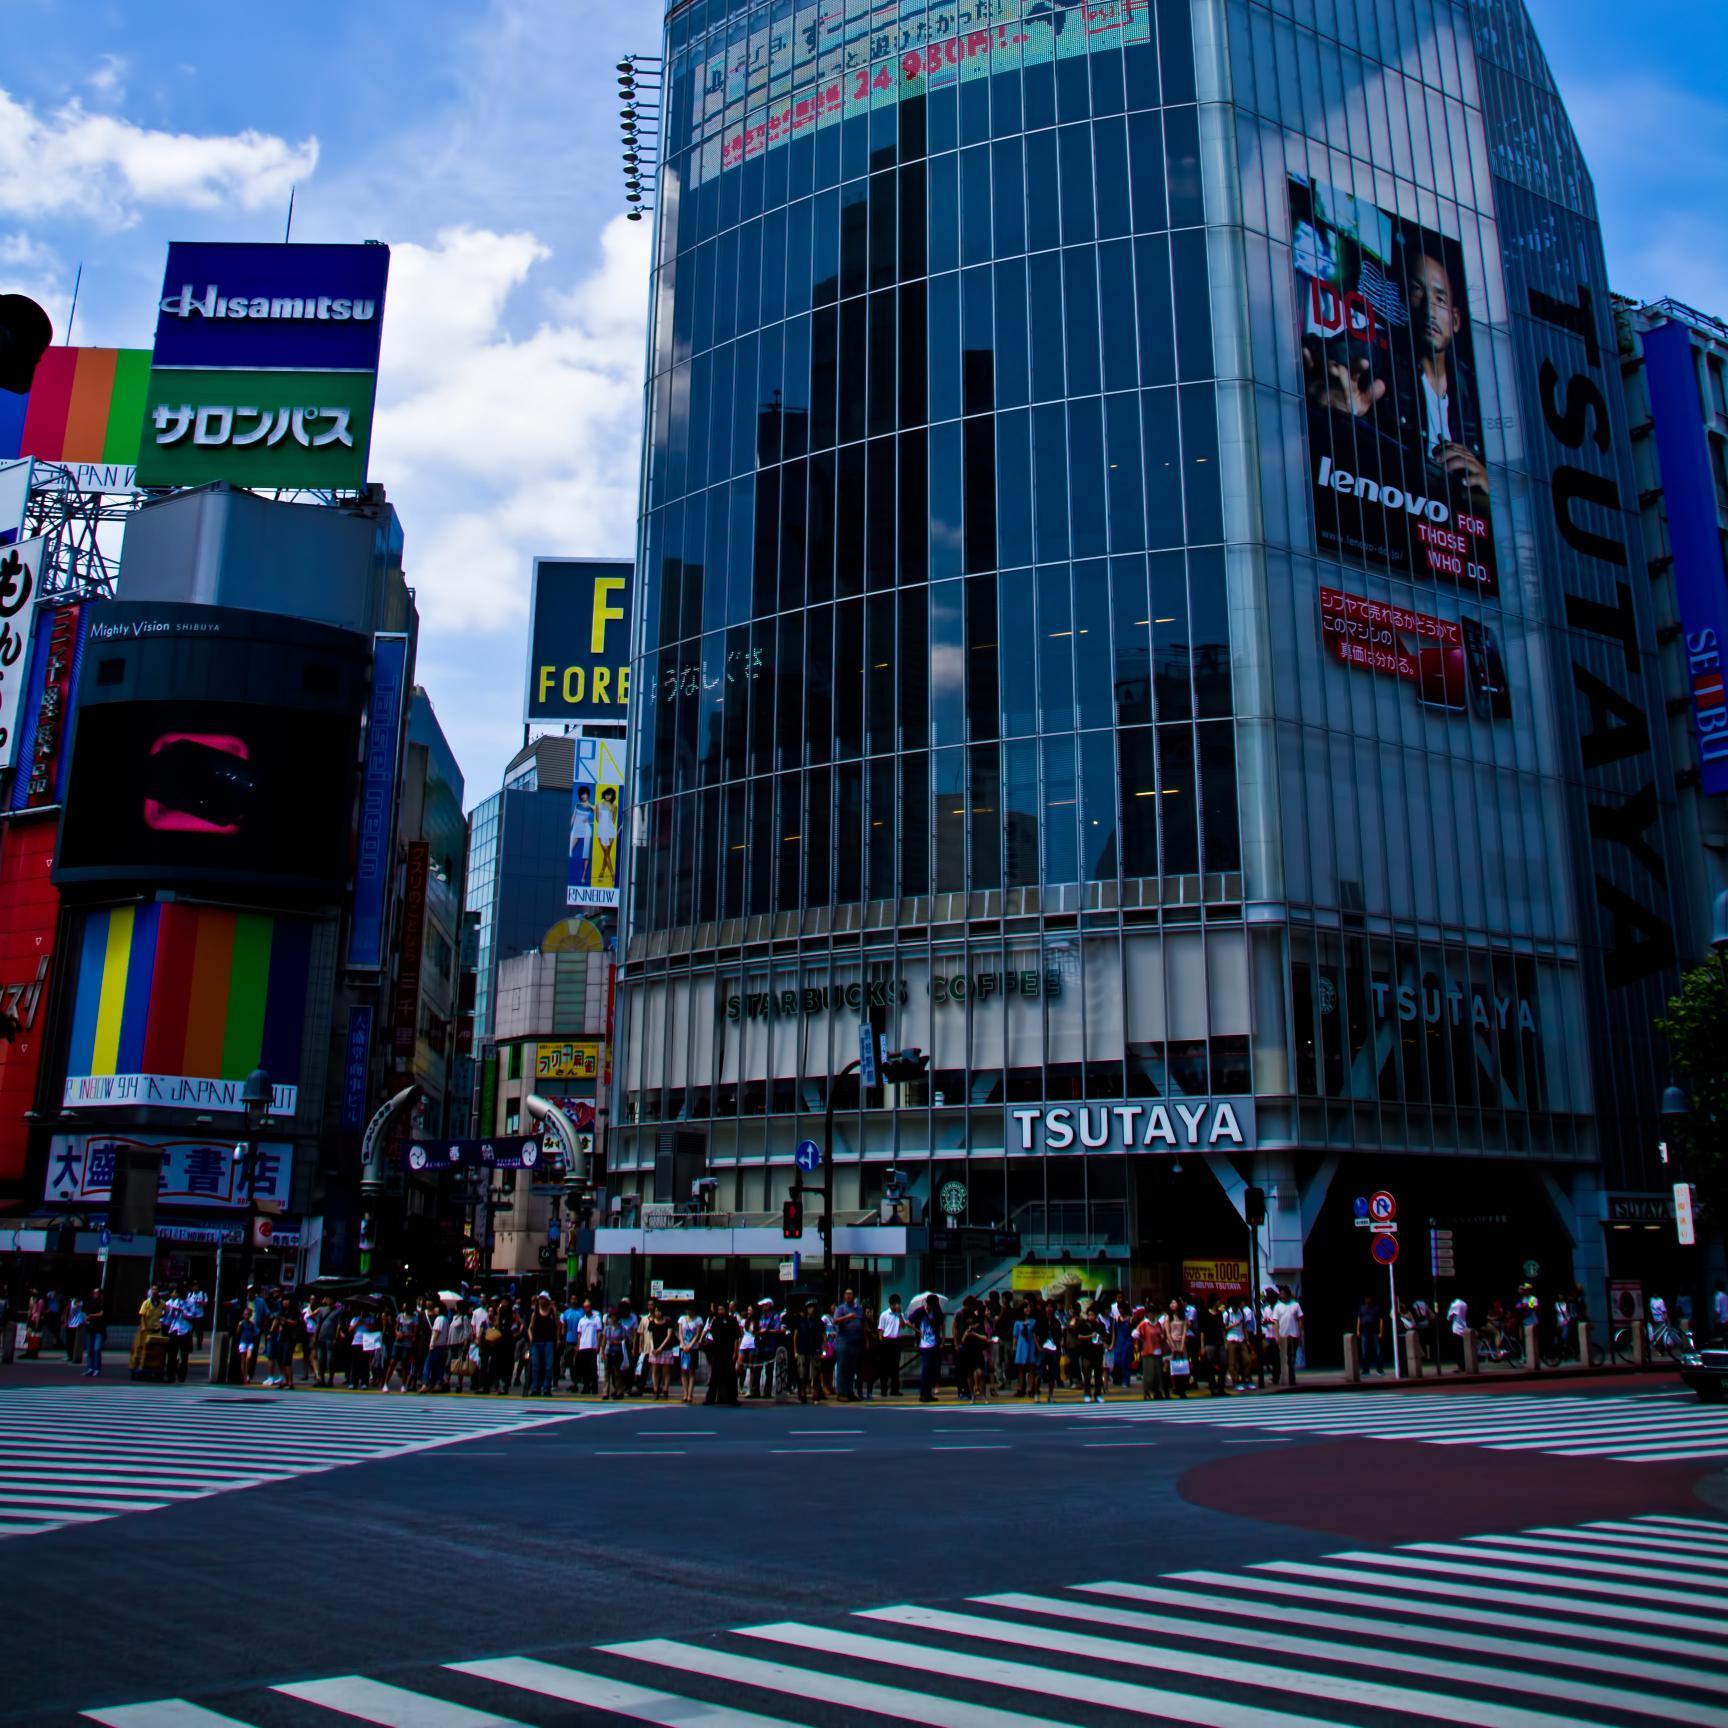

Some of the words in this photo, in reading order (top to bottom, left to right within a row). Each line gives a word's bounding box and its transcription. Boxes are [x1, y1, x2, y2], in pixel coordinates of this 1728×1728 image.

[160, 284, 376, 320] Hisamitsu
[152, 404, 353, 447] サロンパス
[1317, 456, 1450, 523] lenovo
[1417, 524, 1467, 553] THOSE
[1457, 514, 1485, 537] FOR
[1427, 549, 1462, 575] WHO
[1466, 562, 1492, 584] DO.
[90, 621, 129, 638] Mighty
[131, 620, 170, 637] Vision
[175, 623, 220, 632] SHIBUYA
[1323, 615, 1393, 645] このマシンの
[1528, 283, 1676, 987] TSUTAYA
[1340, 643, 1417, 675] 真価は分かる。
[1686, 628, 1728, 761] SEIBU
[727, 978, 906, 1020] STARBUCKS
[928, 968, 1062, 1003] COFFEE
[1370, 982, 1537, 1033] TSUTAYA
[171, 1079, 236, 1105] JAPAN
[1013, 1102, 1244, 1149] TSUTAYA
[54, 1145, 280, 1195] 大盛書店
